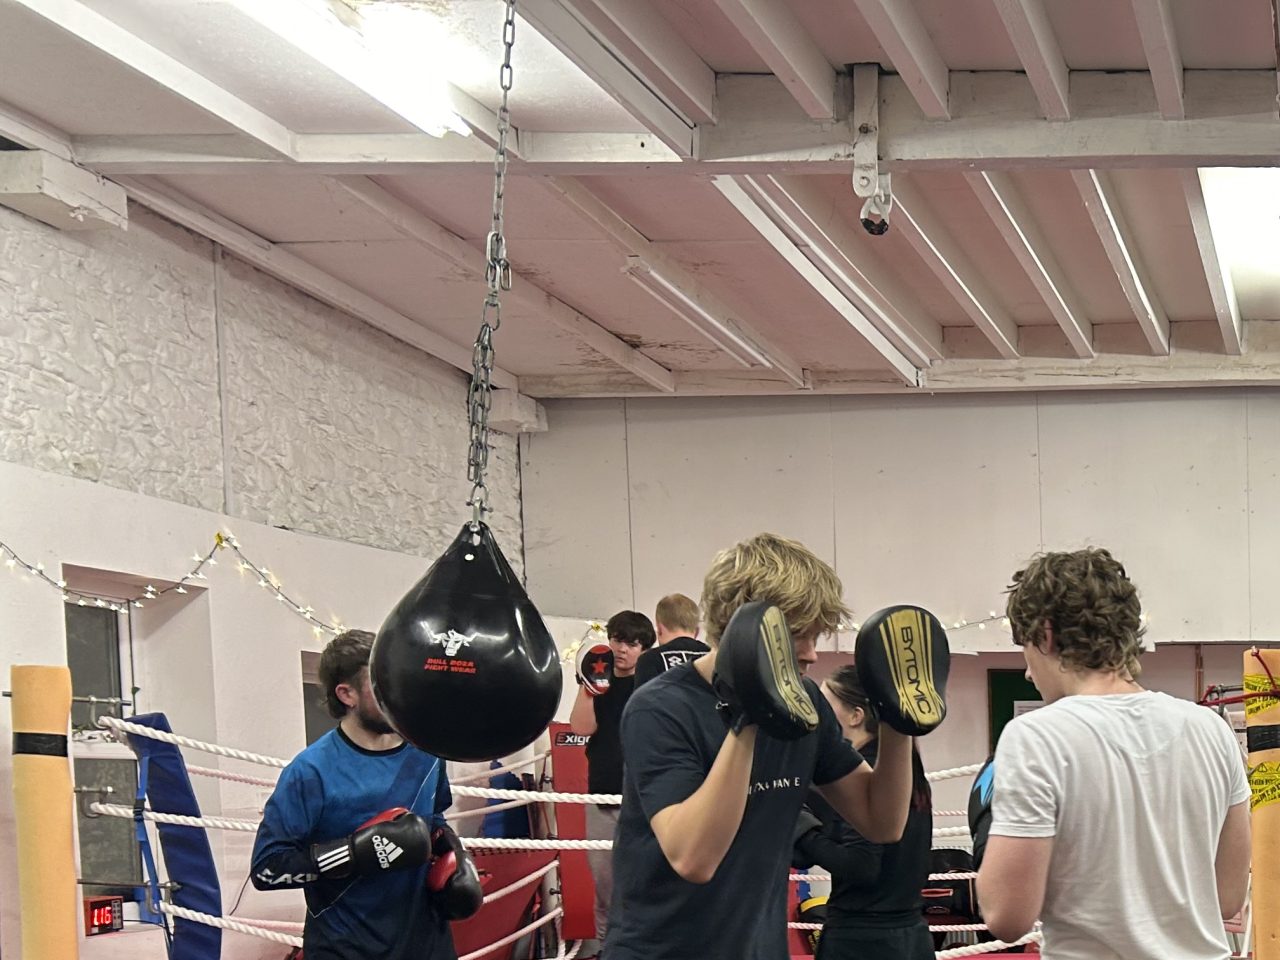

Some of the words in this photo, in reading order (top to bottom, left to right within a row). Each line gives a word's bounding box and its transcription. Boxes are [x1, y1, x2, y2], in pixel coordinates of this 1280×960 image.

[427, 658, 447, 666] BULL
[450, 666, 477, 674] WEAR
[774, 624, 813, 716] BYTOMIC
[901, 626, 932, 715] BYTOMIC
[371, 835, 390, 869] adidas
